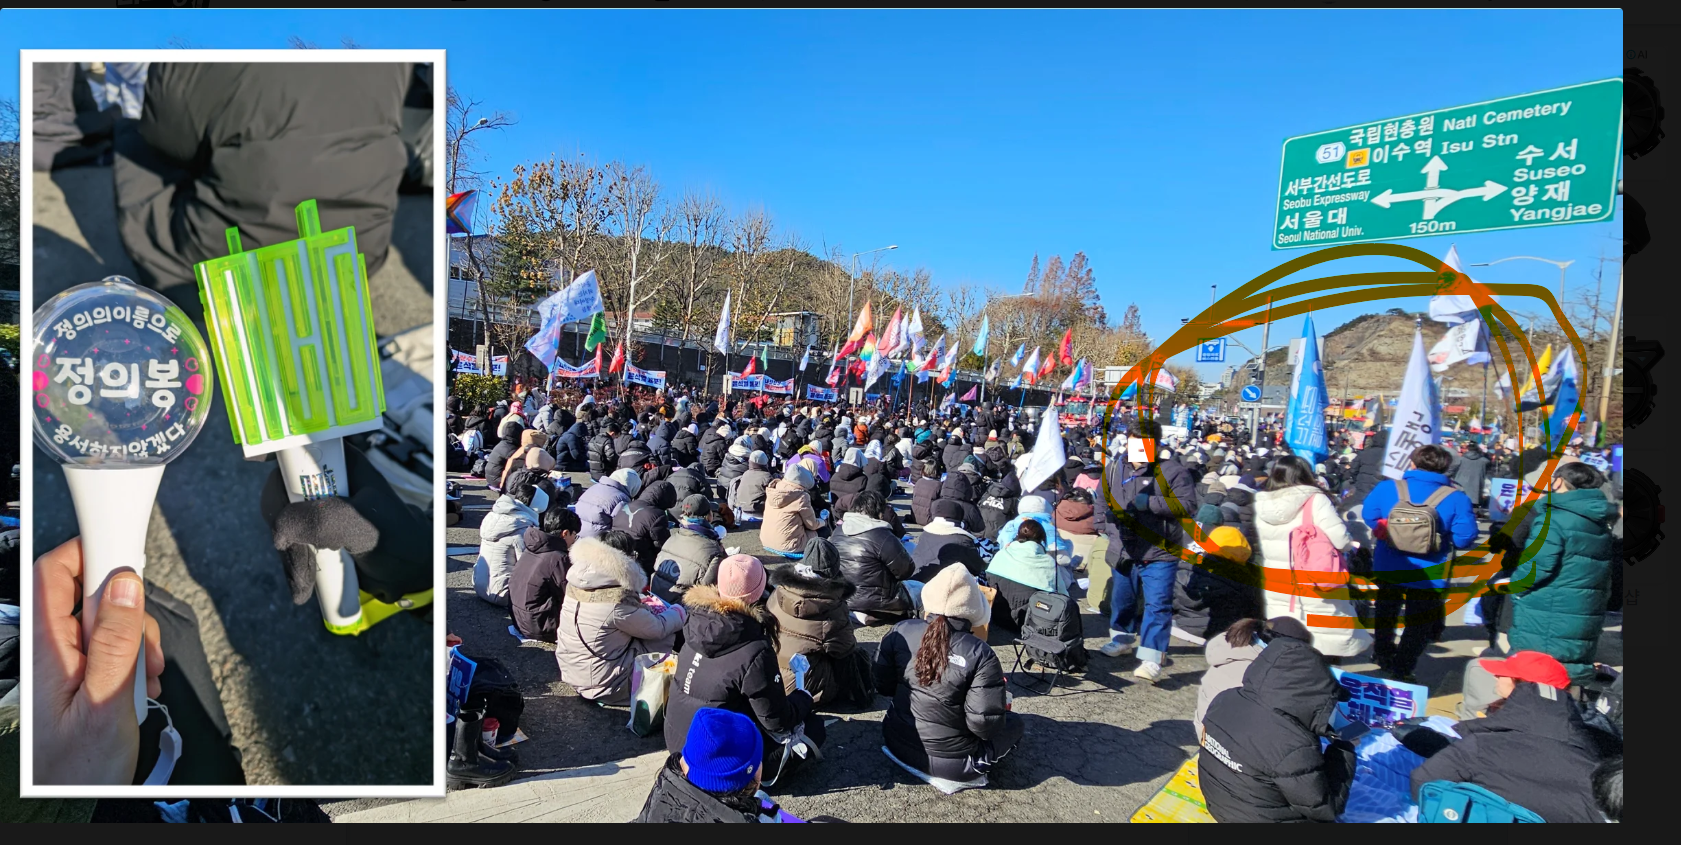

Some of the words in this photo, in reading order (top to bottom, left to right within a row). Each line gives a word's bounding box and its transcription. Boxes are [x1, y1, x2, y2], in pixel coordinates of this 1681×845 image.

[1349, 115, 1434, 146] 국립현충원
[1443, 114, 1477, 131] Natl
[1483, 101, 1572, 125] Cemetery
[1322, 145, 1340, 159] 51
[1373, 138, 1432, 163] 이수역
[1440, 140, 1474, 154] Isu
[1482, 133, 1519, 148] Stn
[1515, 138, 1578, 165] 수서
[1284, 168, 1372, 196] 서부간선도로
[1513, 164, 1586, 182] Suseo
[1283, 196, 1311, 210] Seobu
[1314, 190, 1370, 207] Expressway
[1511, 180, 1571, 206] 양재
[1280, 207, 1348, 230] 서울대
[1510, 203, 1602, 222] Yangjae
[1278, 230, 1301, 244] Seoul
[1303, 227, 1340, 241] National
[1342, 225, 1364, 238] Univ.
[1409, 220, 1456, 234] 150m
[53, 305, 182, 344] 정의의이름으로
[53, 357, 182, 408] 정의봉
[53, 421, 186, 461] 용서하지않겠다
[683, 667, 696, 695] team
